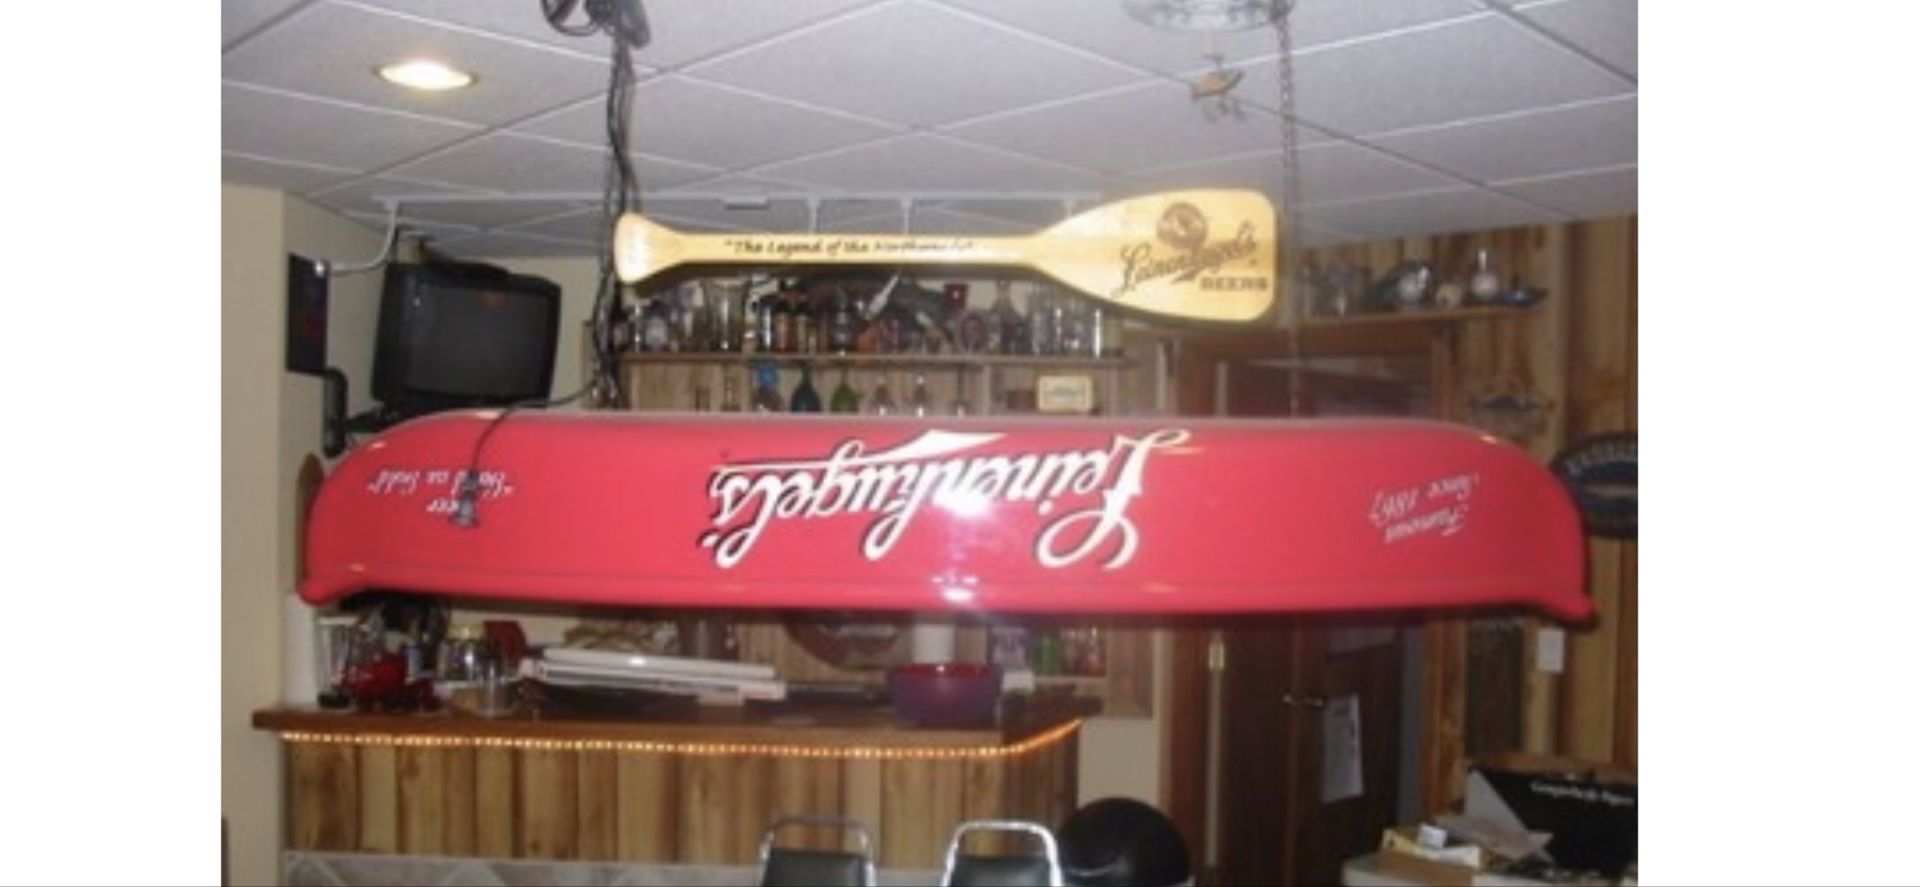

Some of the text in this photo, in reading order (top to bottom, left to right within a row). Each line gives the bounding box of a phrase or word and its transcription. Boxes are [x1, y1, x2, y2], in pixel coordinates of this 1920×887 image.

[767, 238, 823, 261] Legend
[827, 239, 842, 258] of
[844, 239, 869, 254] the
[1200, 276, 1268, 292] BEERS
[426, 470, 449, 485] as
[451, 470, 514, 498] "God
[698, 429, 1190, 568] Leinenkugel's
